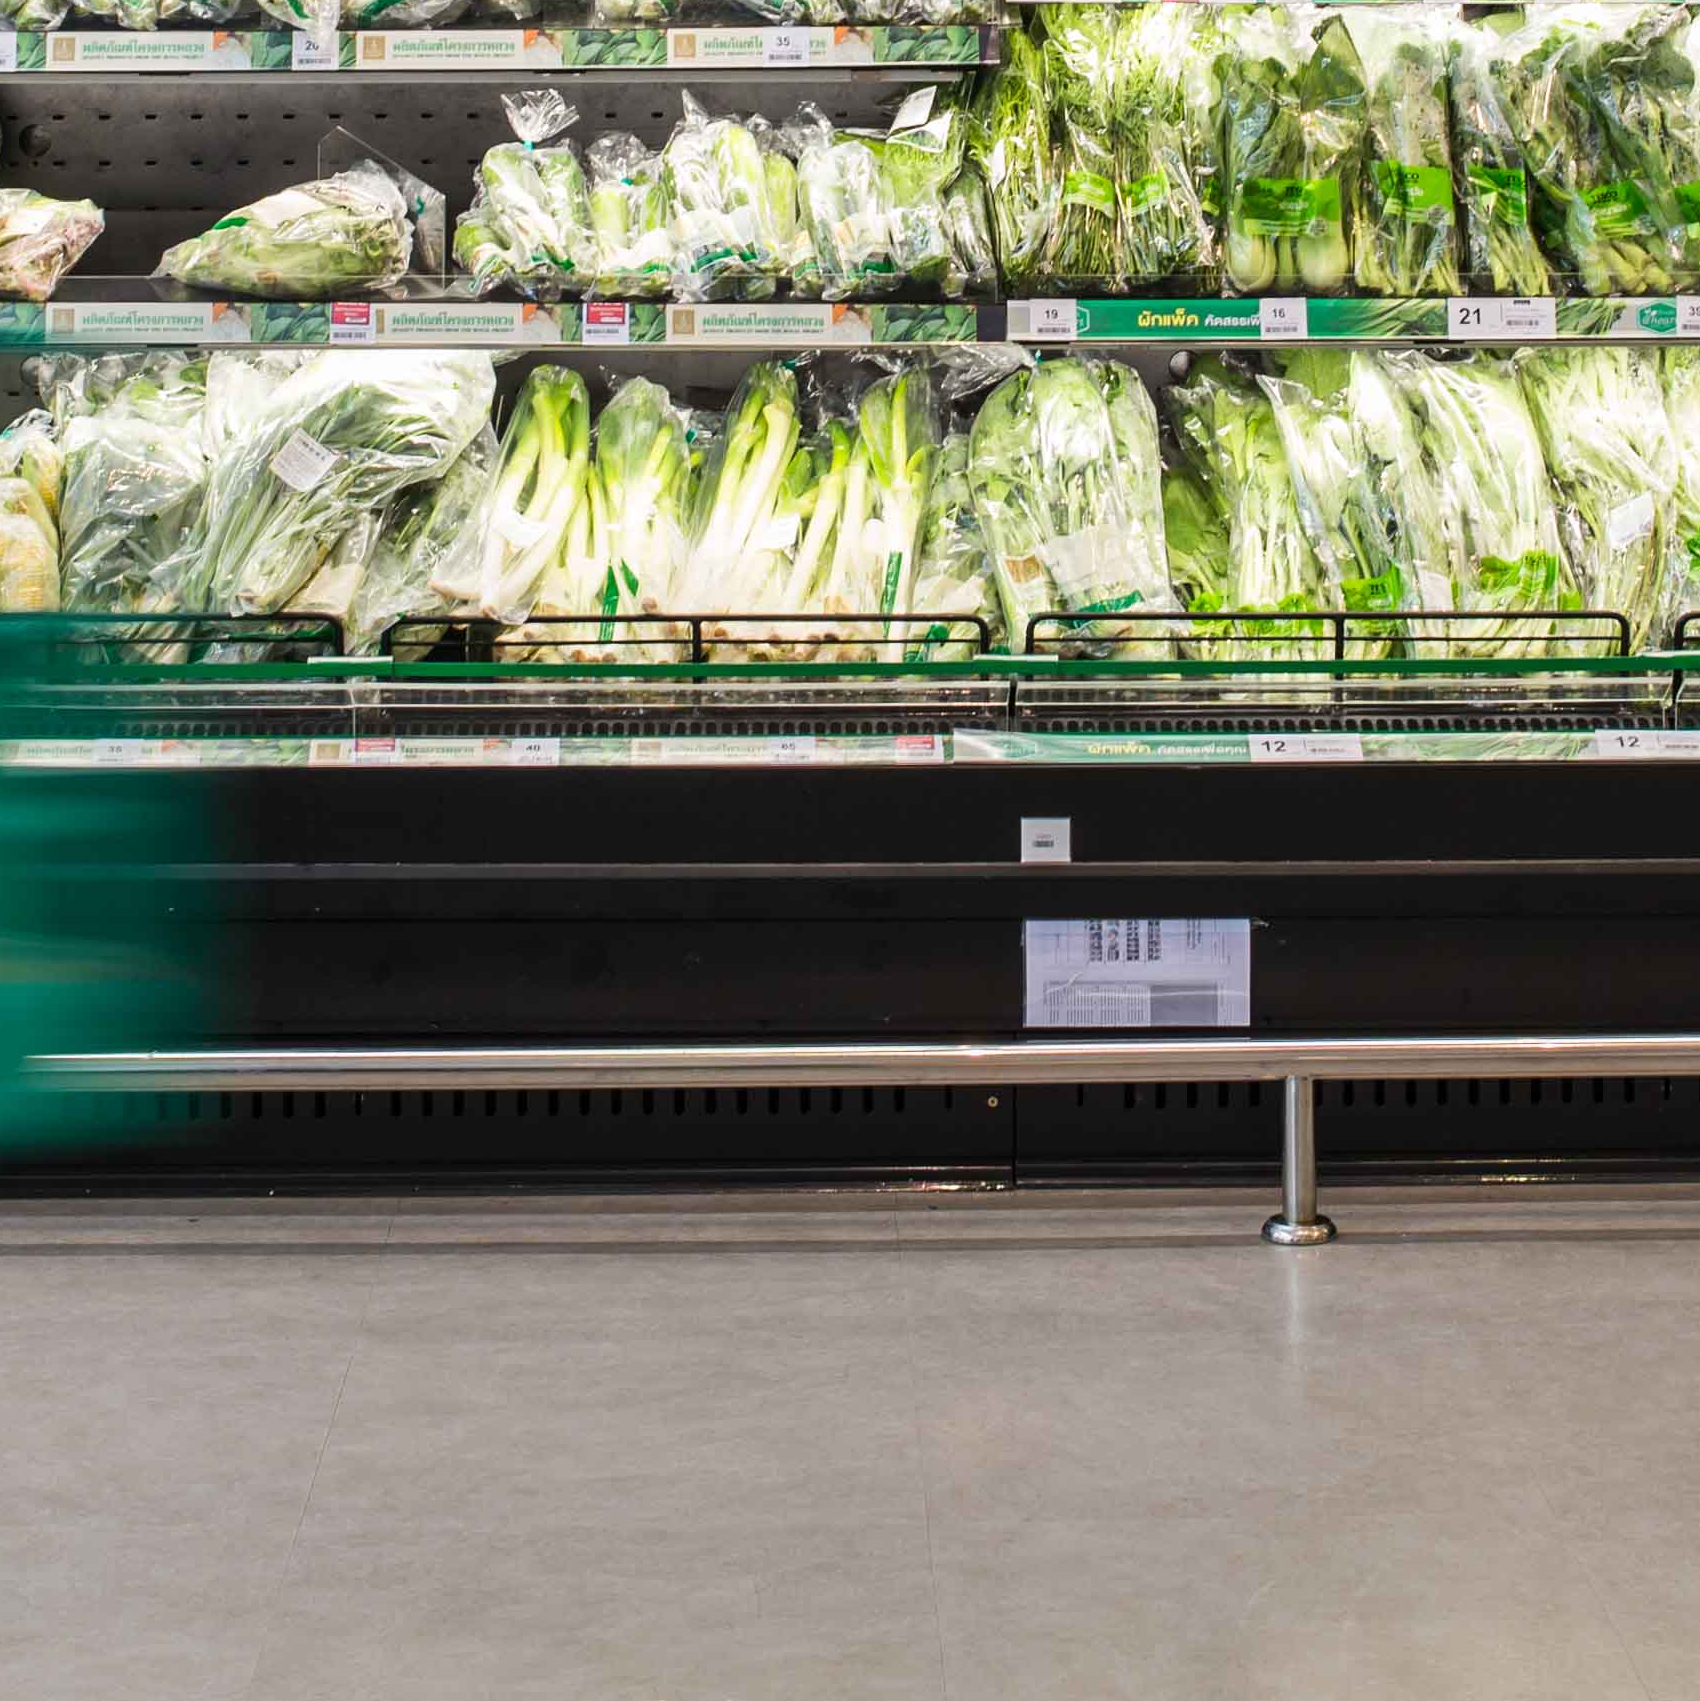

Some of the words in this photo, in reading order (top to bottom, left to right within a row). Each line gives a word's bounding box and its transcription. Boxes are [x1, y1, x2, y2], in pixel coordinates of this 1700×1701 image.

[778, 37, 790, 46] 35
[1046, 310, 1058, 318] 19
[1138, 307, 1198, 326] ผักแพ็ค
[1273, 309, 1285, 318] 16
[1460, 308, 1480, 324] 21
[1262, 741, 1285, 751] 12
[1616, 737, 1638, 747] 12
